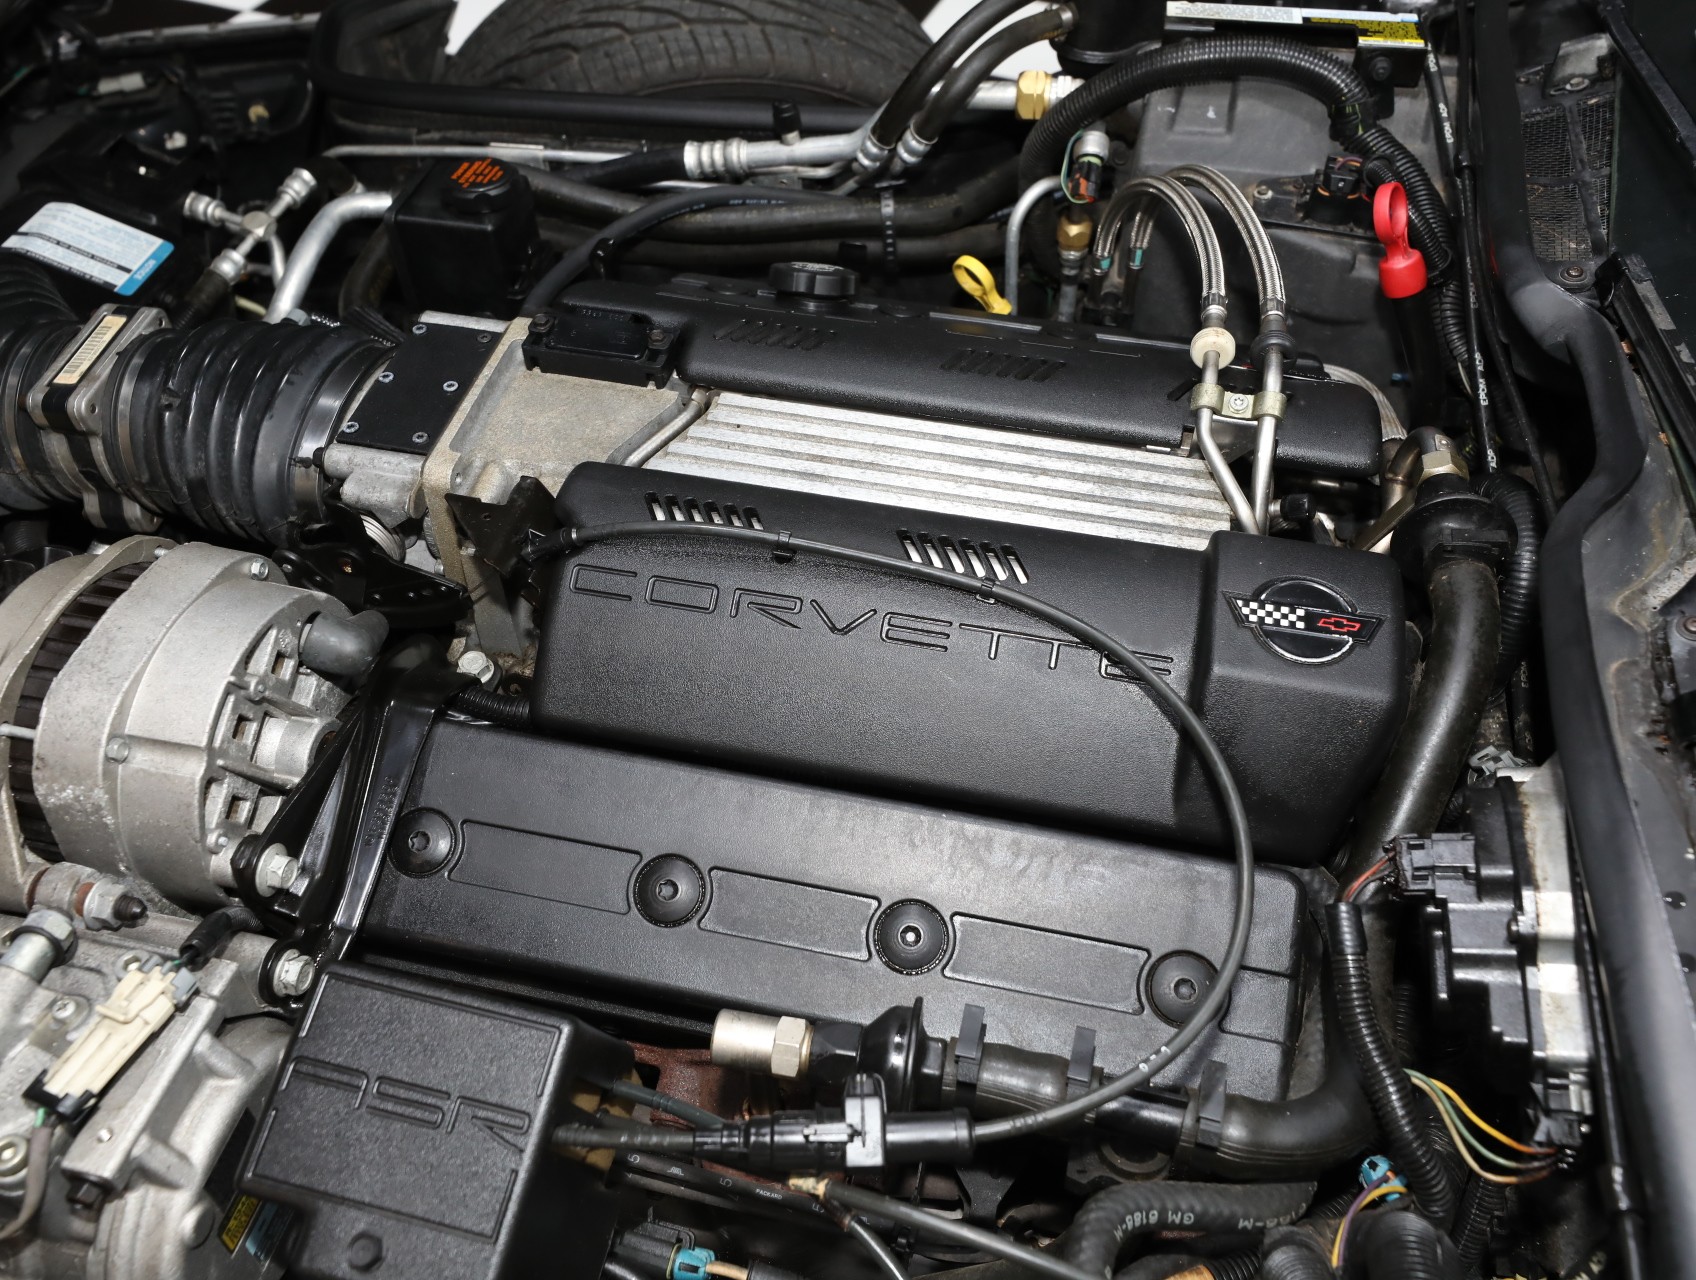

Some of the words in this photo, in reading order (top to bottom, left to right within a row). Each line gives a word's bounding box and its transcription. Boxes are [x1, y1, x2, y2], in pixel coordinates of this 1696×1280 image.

[1443, 121, 1454, 143] EPDM
[1474, 351, 1484, 372] ADP
[1478, 378, 1489, 406] EPDM
[1487, 448, 1497, 469] ADP
[569, 562, 1174, 685] CORVETTE
[278, 1055, 532, 1153] ASR
[755, 1188, 783, 1200] PACKARD
[1113, 1210, 1159, 1242] 6188-M
[1168, 1210, 1195, 1225] GM
